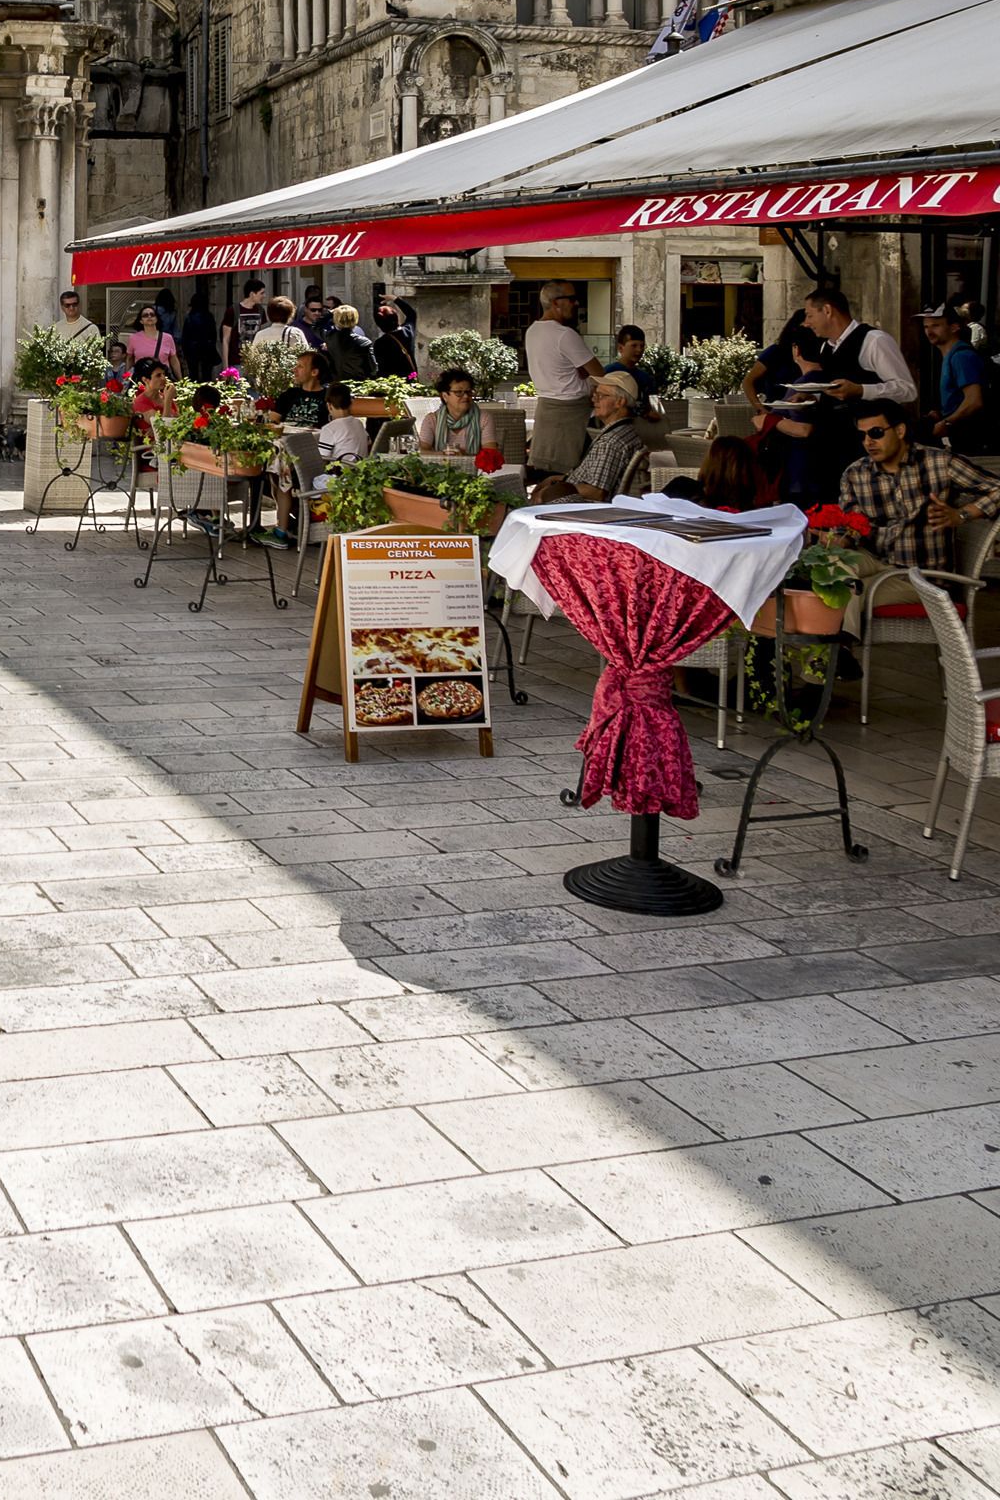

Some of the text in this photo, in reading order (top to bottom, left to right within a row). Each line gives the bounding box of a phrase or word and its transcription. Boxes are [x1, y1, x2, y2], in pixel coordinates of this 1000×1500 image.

[619, 171, 978, 228] RESTAURANT
[131, 231, 367, 277] GRADSKA KAVANA CENTRAL
[351, 541, 420, 549] RESTAURANT
[429, 540, 470, 548] KAVANA
[387, 550, 436, 558] CENTRAL
[389, 570, 436, 580] PIZZA
